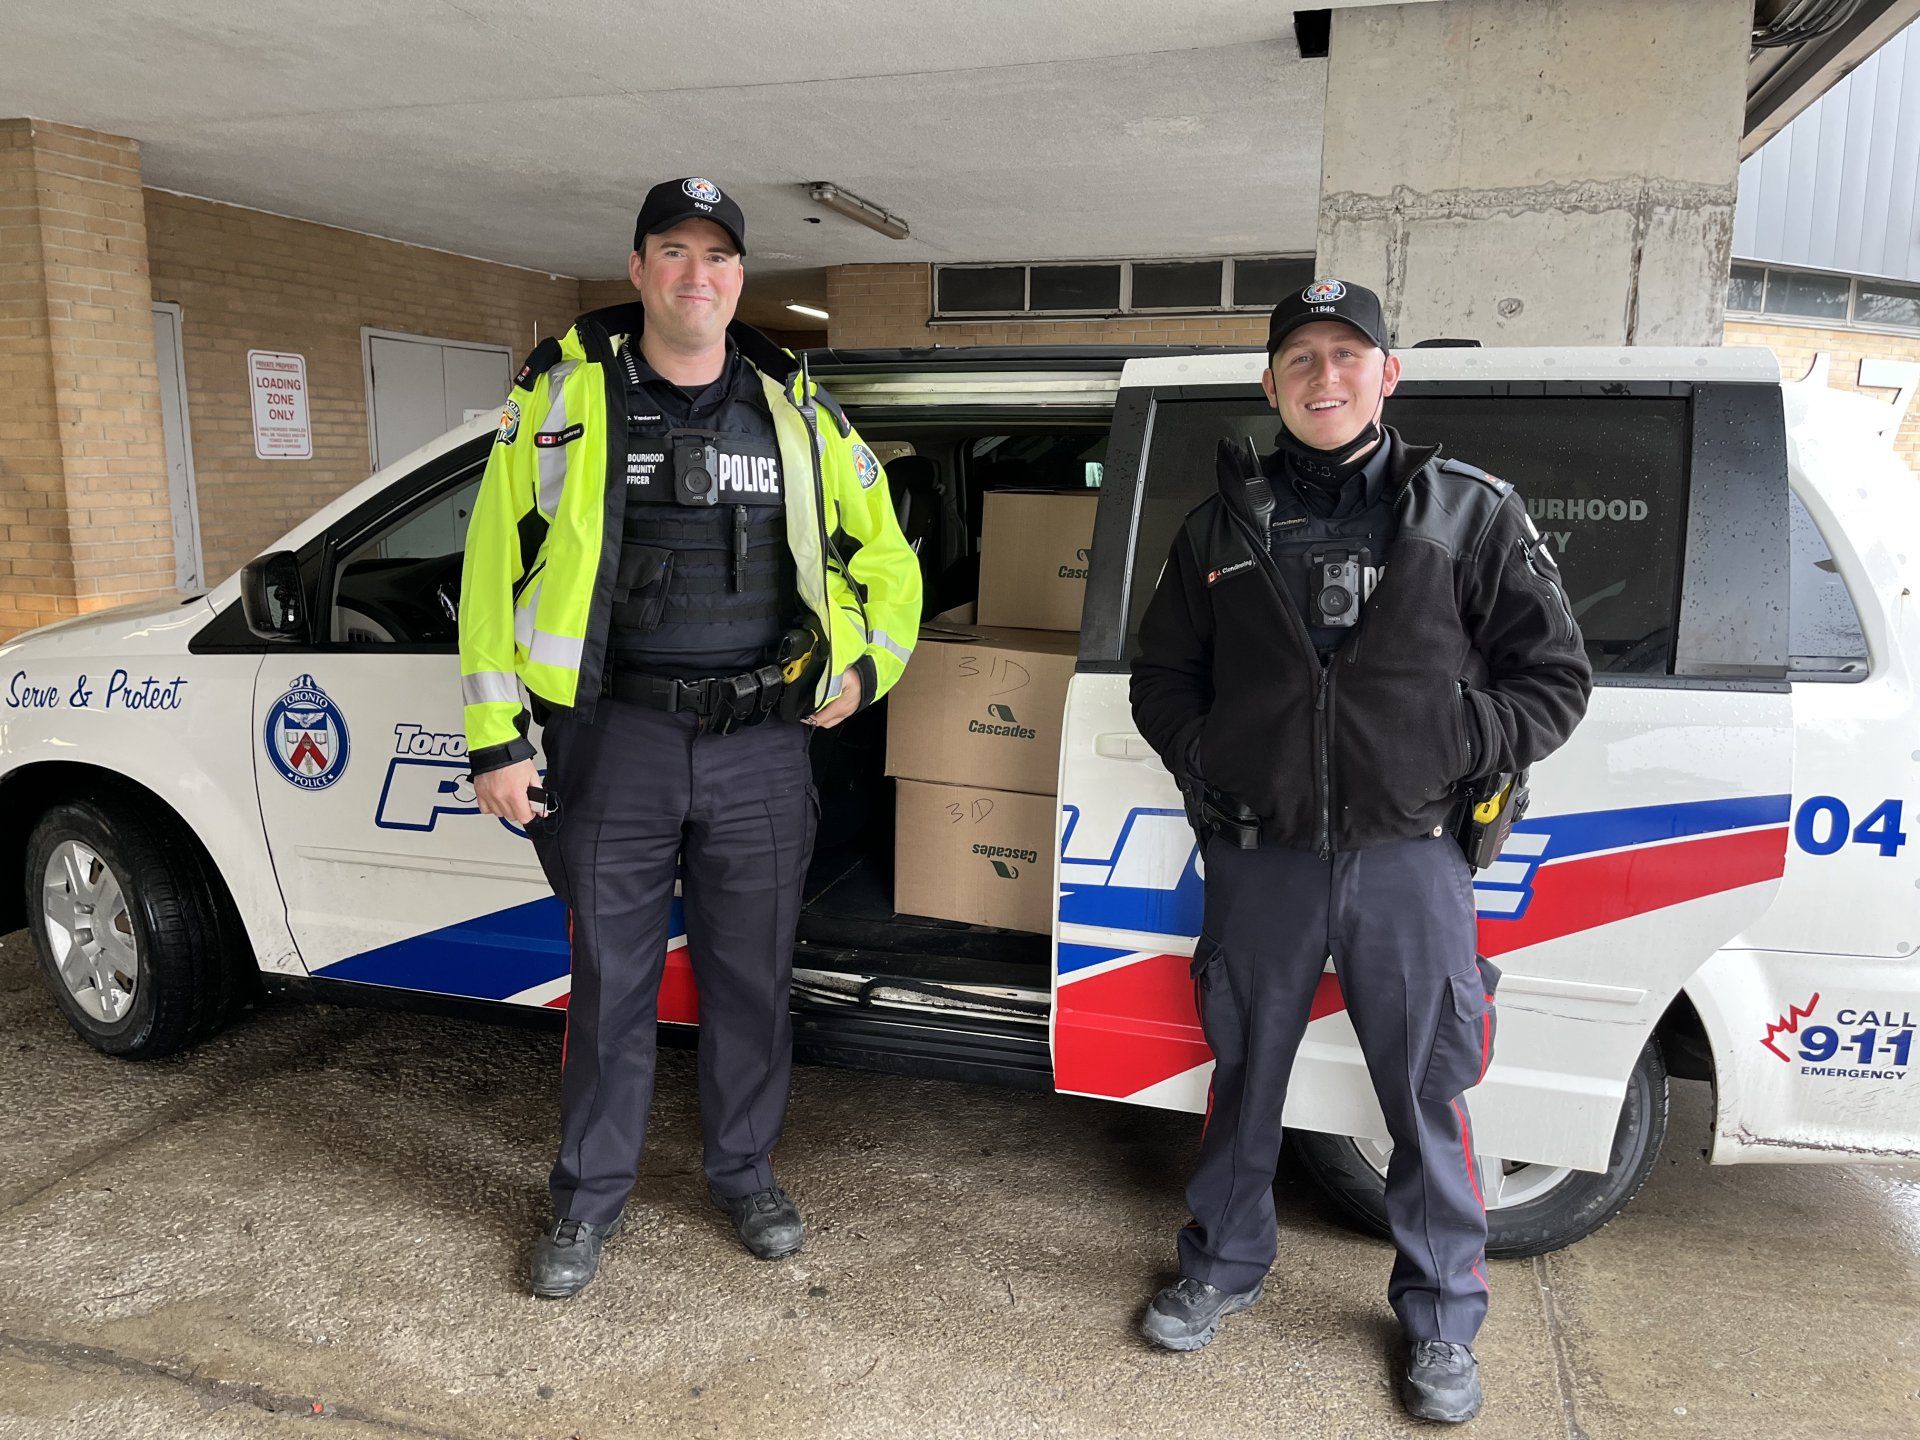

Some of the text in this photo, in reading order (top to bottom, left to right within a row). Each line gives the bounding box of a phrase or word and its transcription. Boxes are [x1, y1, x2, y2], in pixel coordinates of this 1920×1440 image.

[694, 202, 713, 212] 9457
[1311, 305, 1336, 313] 11846
[256, 377, 301, 390] LOADING
[267, 393, 295, 405] ZONE
[269, 409, 294, 420] ONLY
[627, 453, 665, 463] BOURHOOD
[626, 475, 650, 485] FFICER
[719, 453, 779, 494] POLICE
[1527, 498, 1649, 521] URHOOD
[6, 669, 188, 710] Serve & Protect
[282, 692, 328, 708] TORONTO
[968, 719, 1036, 740] Cascades
[395, 723, 469, 758] Toro
[294, 774, 328, 788] POLICE
[1794, 795, 1908, 858] 04
[971, 843, 1038, 864] Cascades
[1836, 1009, 1918, 1028] CALL
[1798, 1025, 1914, 1066] 9-1-1
[1801, 1066, 1906, 1080] EMERGENCY
